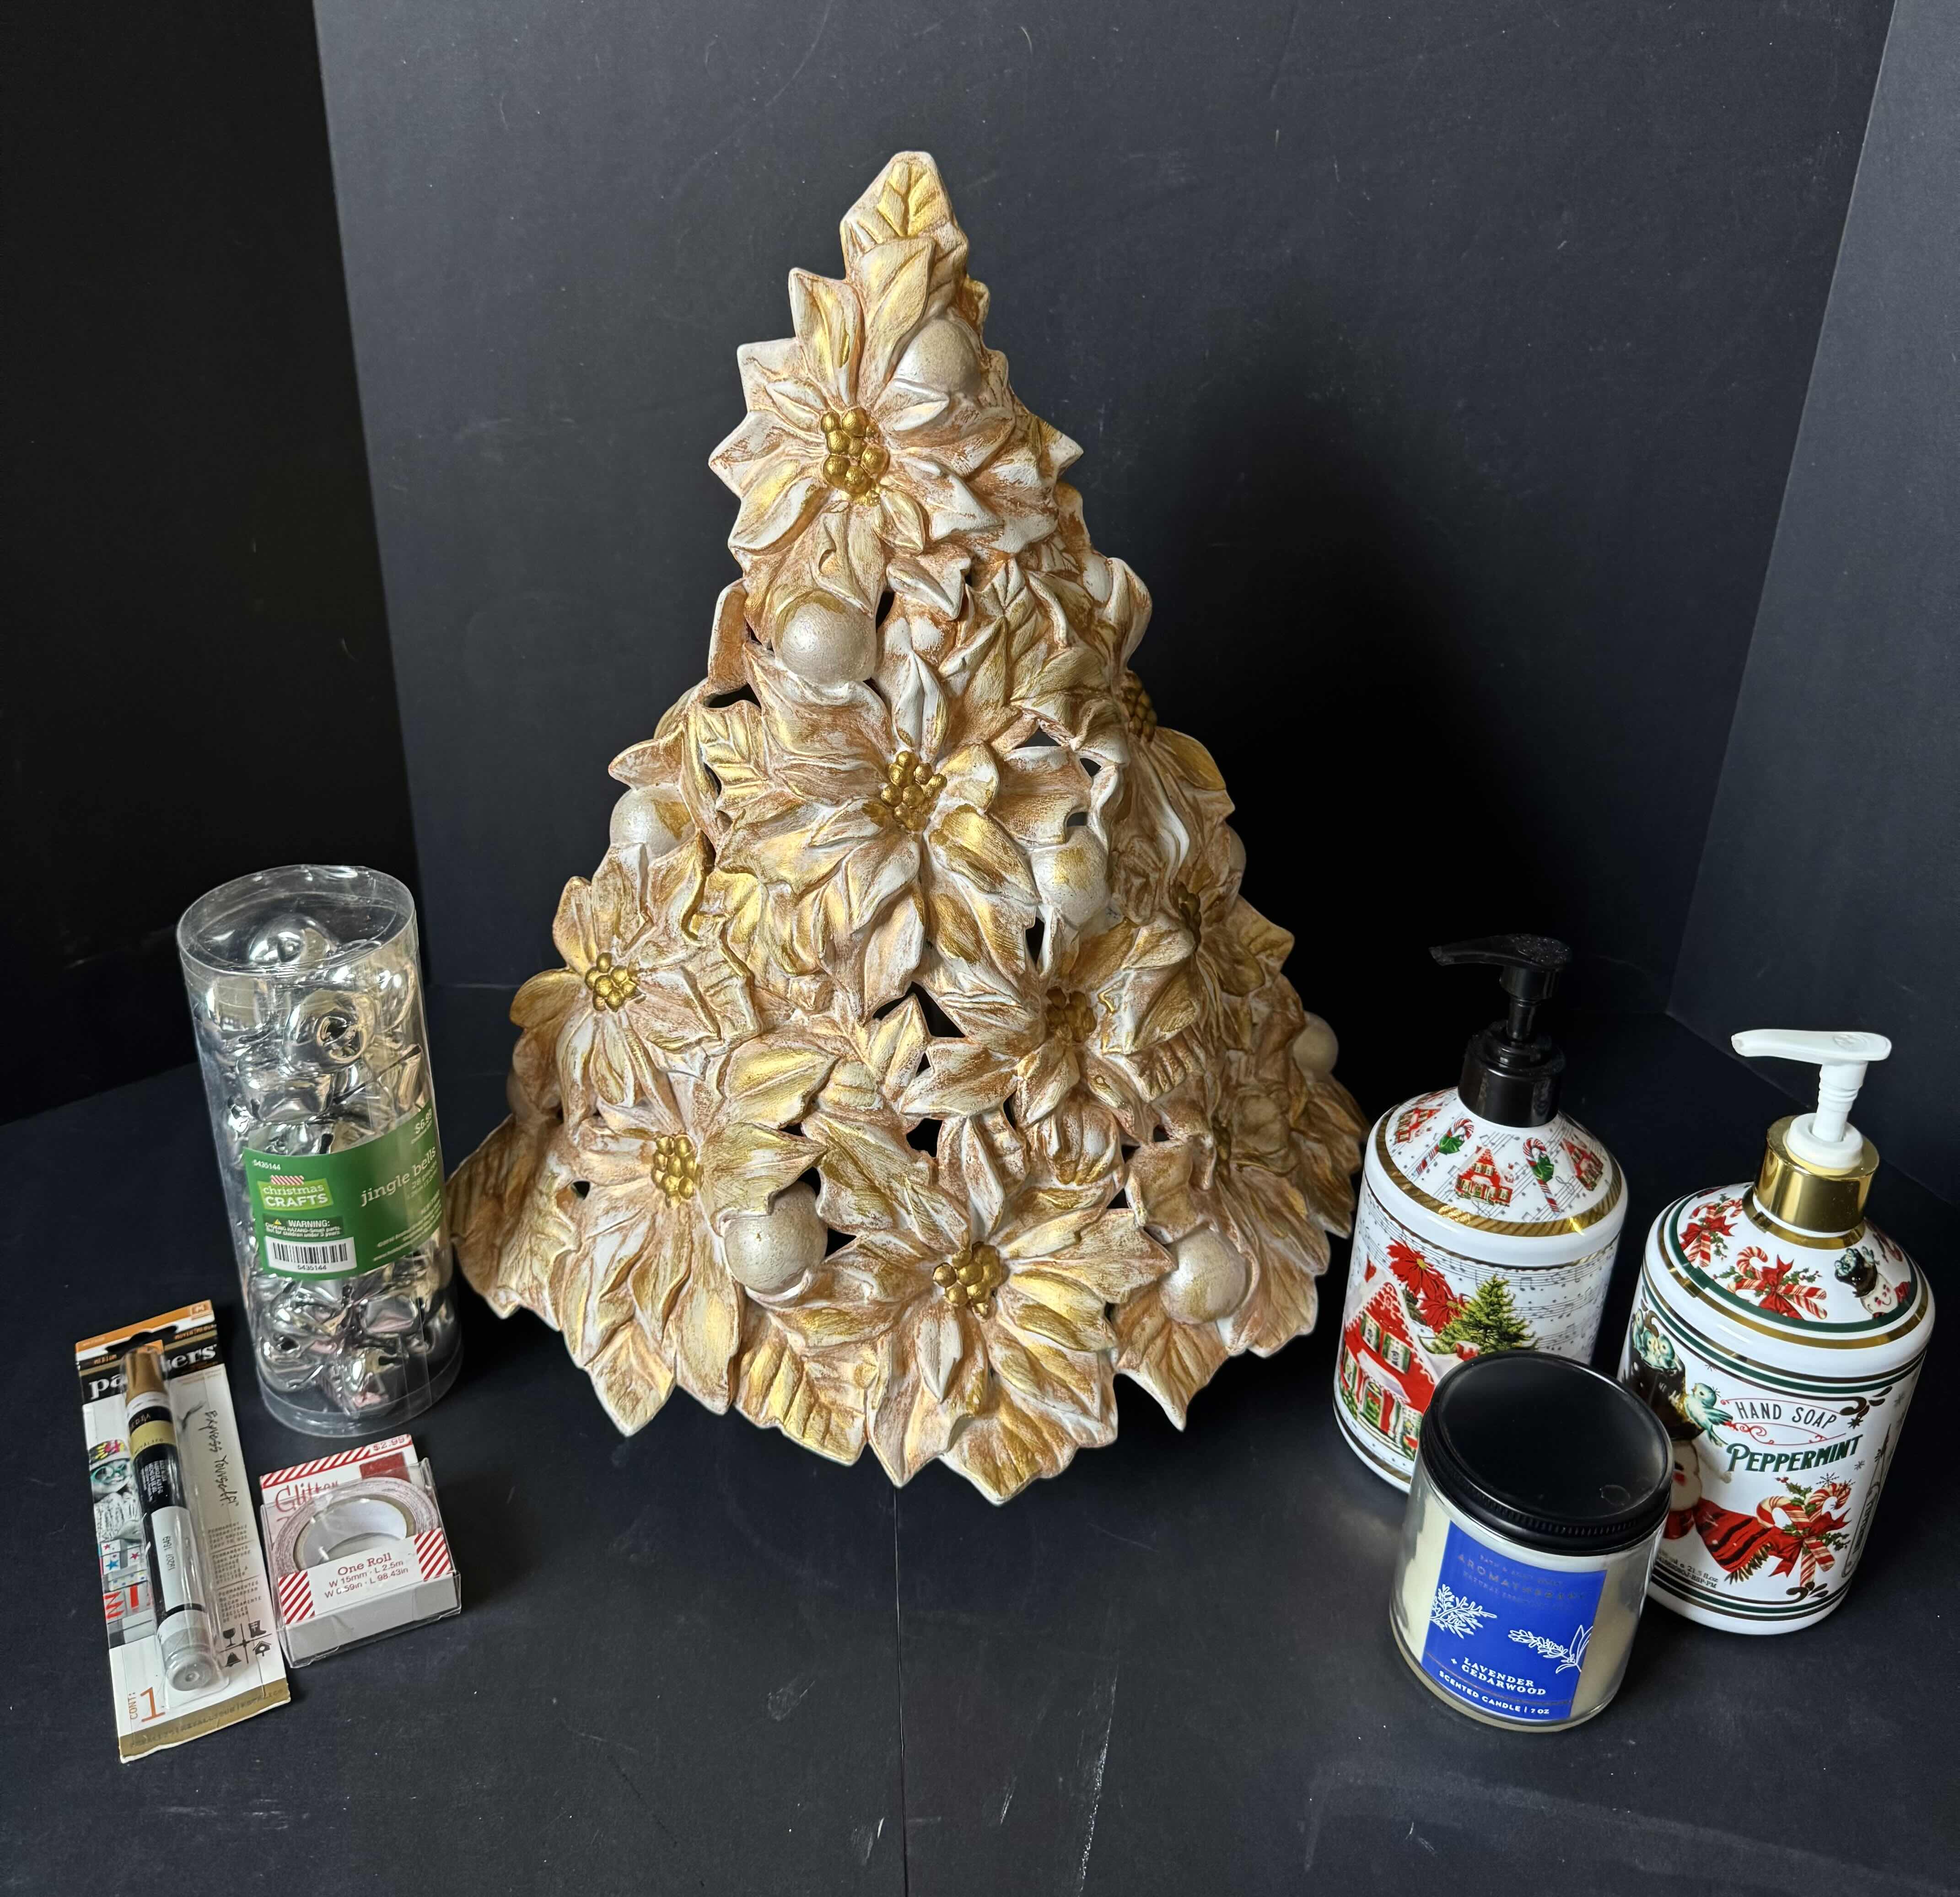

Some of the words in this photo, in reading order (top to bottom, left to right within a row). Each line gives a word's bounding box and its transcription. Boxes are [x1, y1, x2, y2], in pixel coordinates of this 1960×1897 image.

[253, 1159, 280, 1170] 5435144
[360, 1172, 409, 1207] jingle
[412, 1146, 436, 1177] bells
[263, 1185, 324, 1195] christmas
[265, 1193, 328, 1207] CRAFTS
[1735, 1401, 1782, 1420] HAND
[1792, 1406, 1837, 1429] SOAP
[373, 1436, 405, 1451] $2.99
[1726, 1434, 1863, 1472] PEPPERMINT
[329, 1579, 338, 1588] W
[341, 1571, 367, 1584] 15mm
[382, 1560, 404, 1571] 2.5m
[338, 1563, 364, 1575] One
[366, 1552, 392, 1567] Roll
[324, 1590, 334, 1598] W
[377, 1567, 409, 1581] 98.43in
[1461, 1664, 1546, 1695] CEDARWOOD
[1464, 1657, 1534, 1687] LAVENDER
[140, 1687, 166, 1722] 1
[1439, 1670, 1479, 1698] SCENTED
[1481, 1695, 1521, 1712] CANDLE
